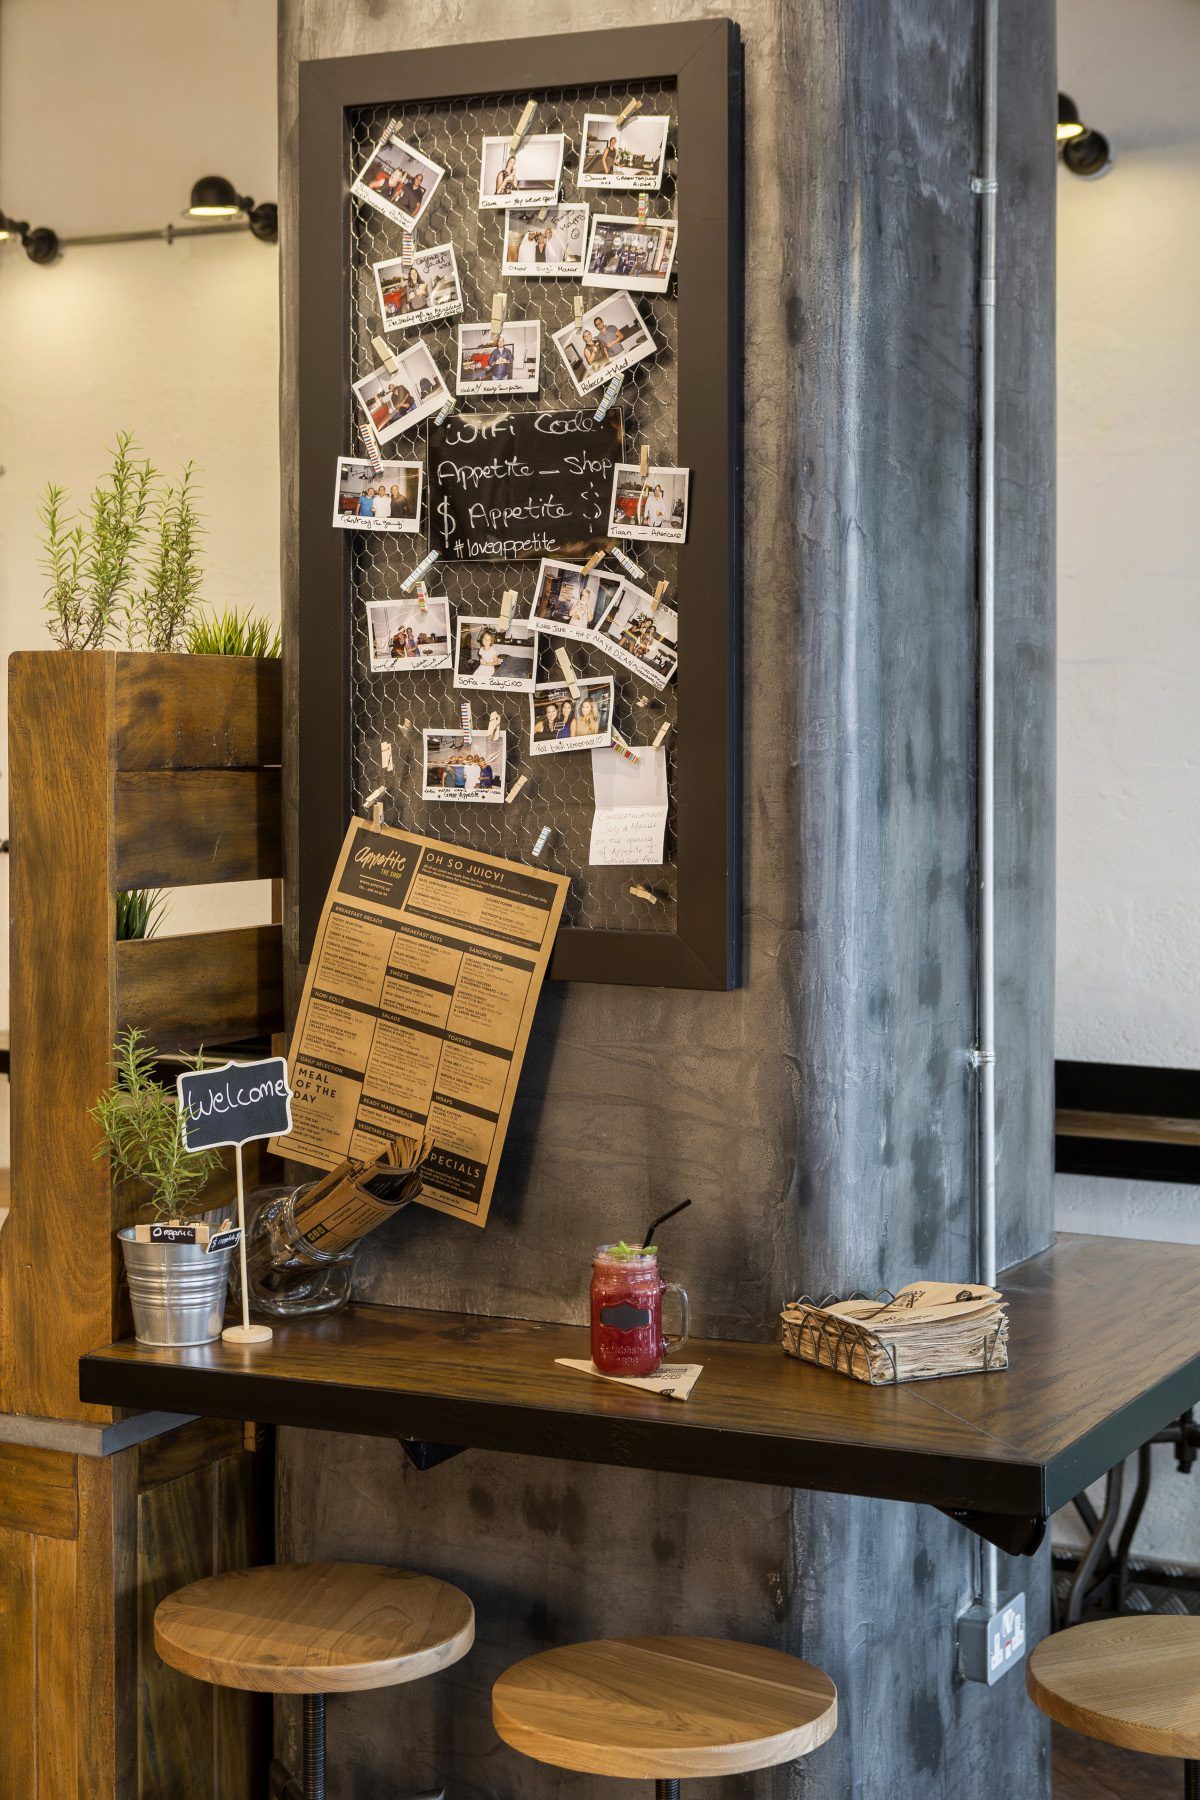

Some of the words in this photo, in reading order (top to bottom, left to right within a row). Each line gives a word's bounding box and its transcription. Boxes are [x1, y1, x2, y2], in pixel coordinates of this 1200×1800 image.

[437, 456, 534, 490] Appetite
[468, 494, 572, 529] Appetite
[352, 839, 409, 880] appetite
[425, 851, 444, 865] OH
[446, 857, 464, 871] SO
[465, 863, 505, 882] JUICY!
[294, 1076, 312, 1091] OF
[313, 1083, 337, 1100] THE
[297, 1066, 330, 1085] MEAL
[189, 1079, 288, 1121] Welcome
[292, 1088, 317, 1105] DAY
[428, 1152, 481, 1179] PECIALS
[152, 1227, 195, 1241] Organic
